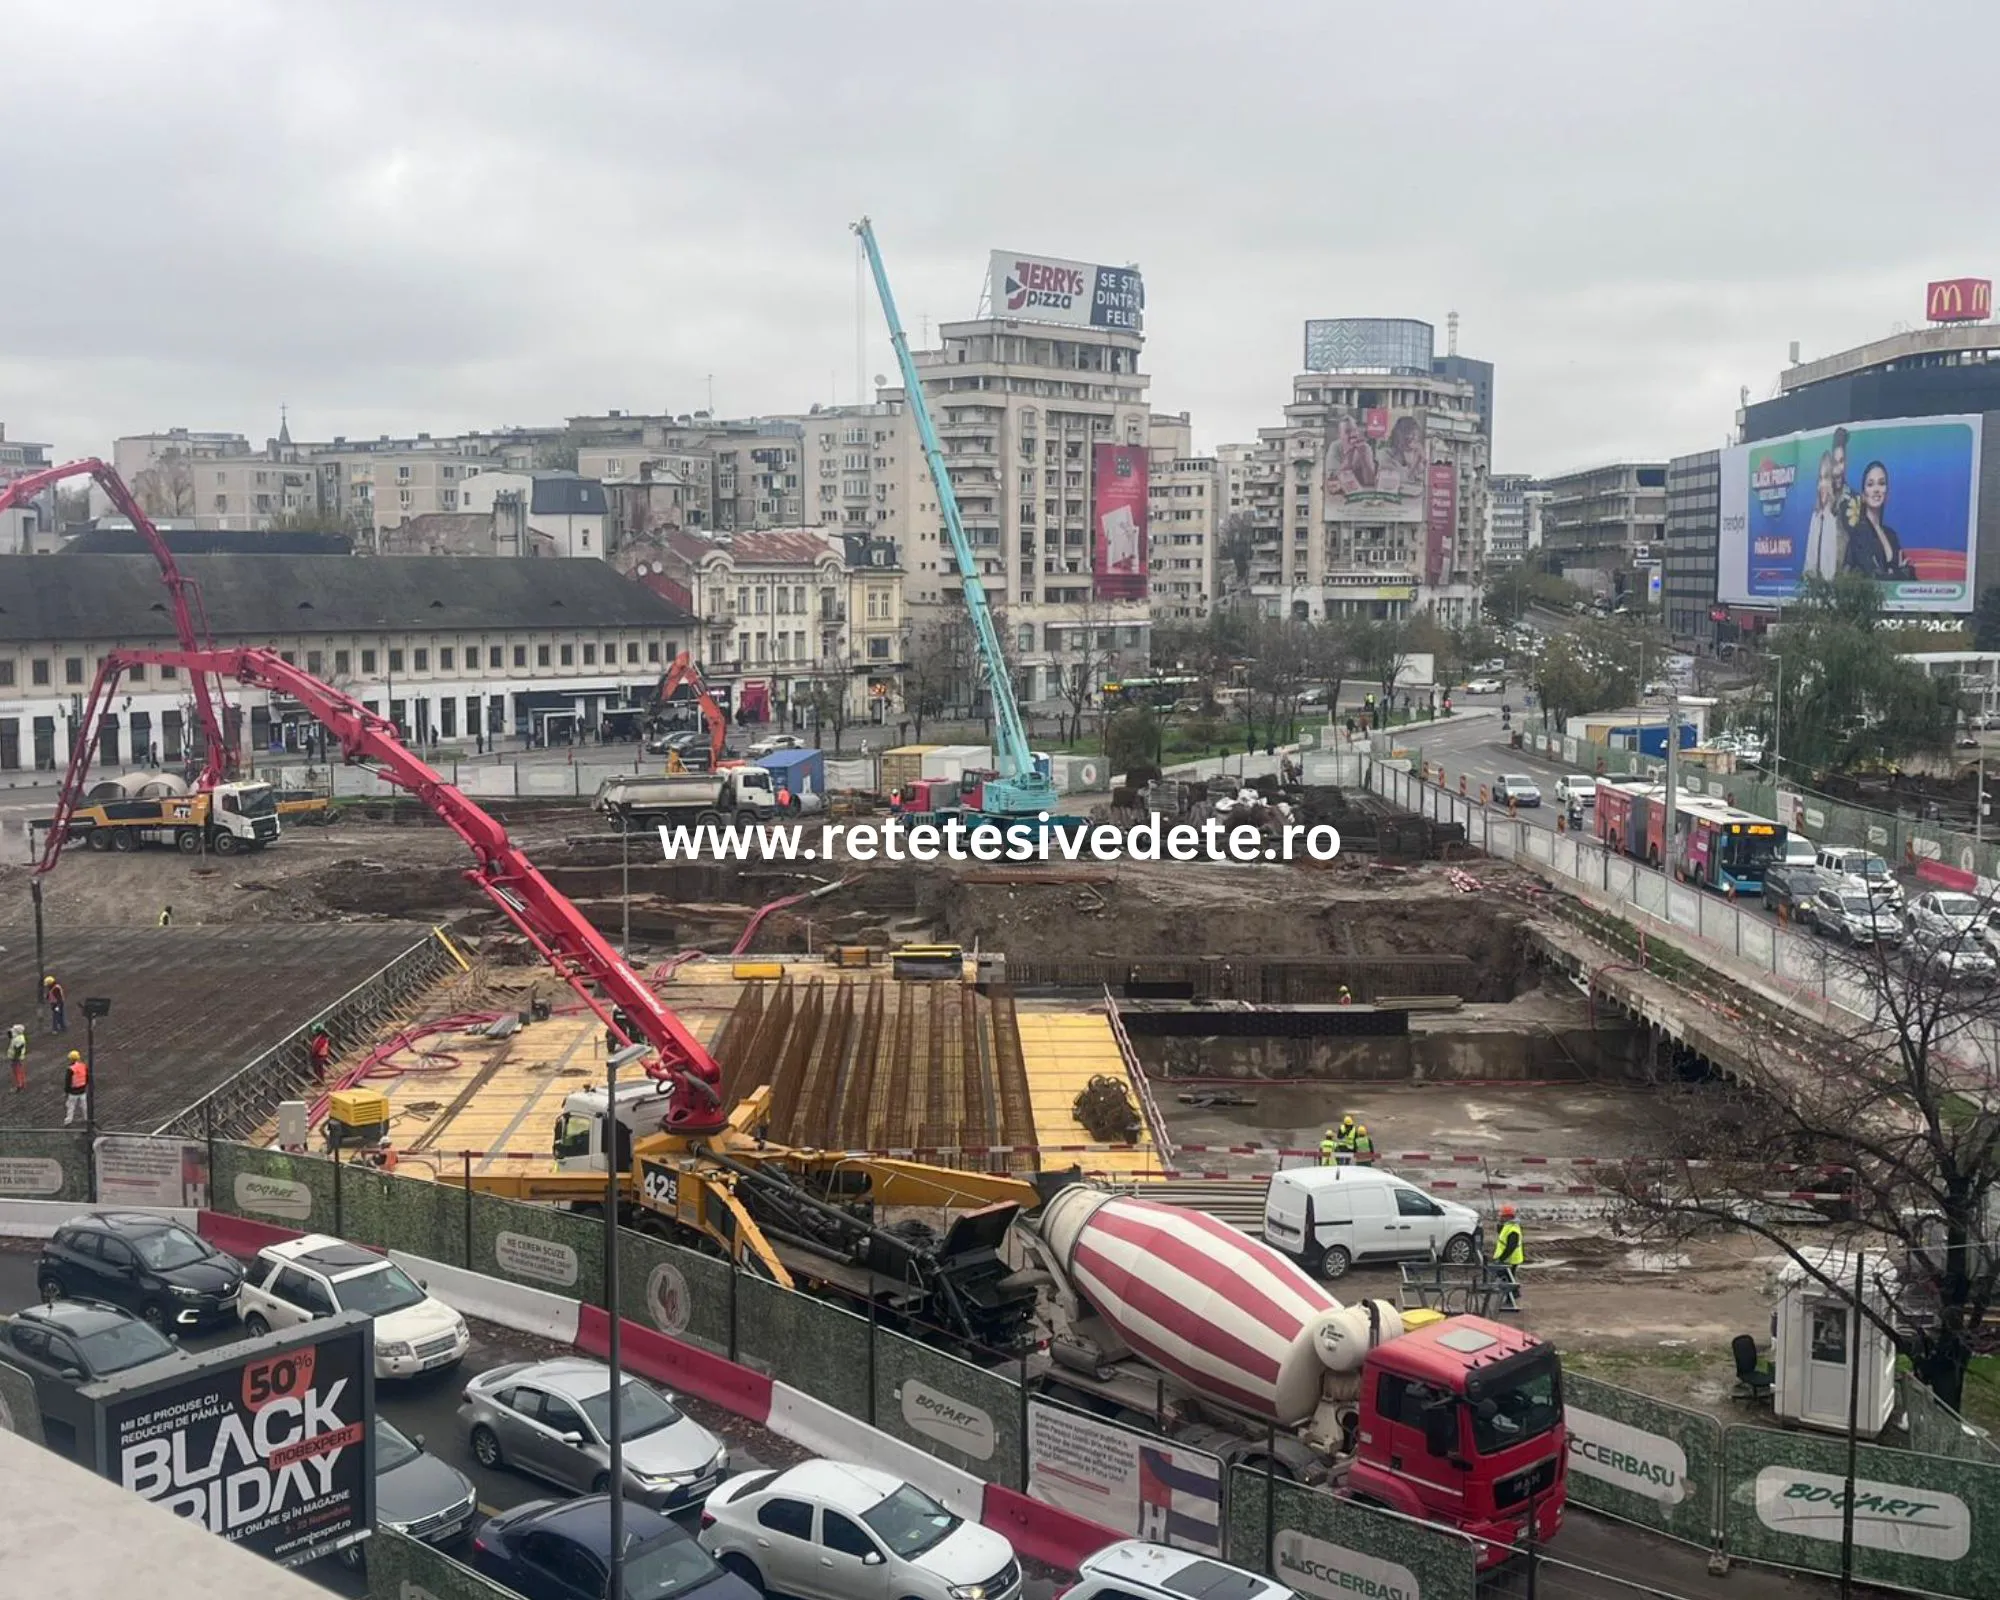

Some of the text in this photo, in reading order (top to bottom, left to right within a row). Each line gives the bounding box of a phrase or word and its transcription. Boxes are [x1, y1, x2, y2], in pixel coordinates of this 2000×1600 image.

[1100, 272, 1116, 288] SE
[1027, 290, 1072, 309] pizza
[1920, 619, 1964, 632] PACK
[250, 1355, 313, 1402] 50%
[121, 1421, 174, 1445] REDUCERI
[175, 1414, 190, 1428] DE
[220, 1401, 234, 1414] LA
[137, 1414, 152, 1427] DE
[153, 1398, 202, 1422] PRODUSE
[203, 1393, 219, 1406] CU
[122, 1377, 349, 1500] BLACK
[1513, 1473, 1541, 1493] MAN
[244, 1516, 281, 1536] ONLINE
[303, 1488, 350, 1515] MAGAZINE
[274, 1519, 351, 1554] www.mobexpert.ro
